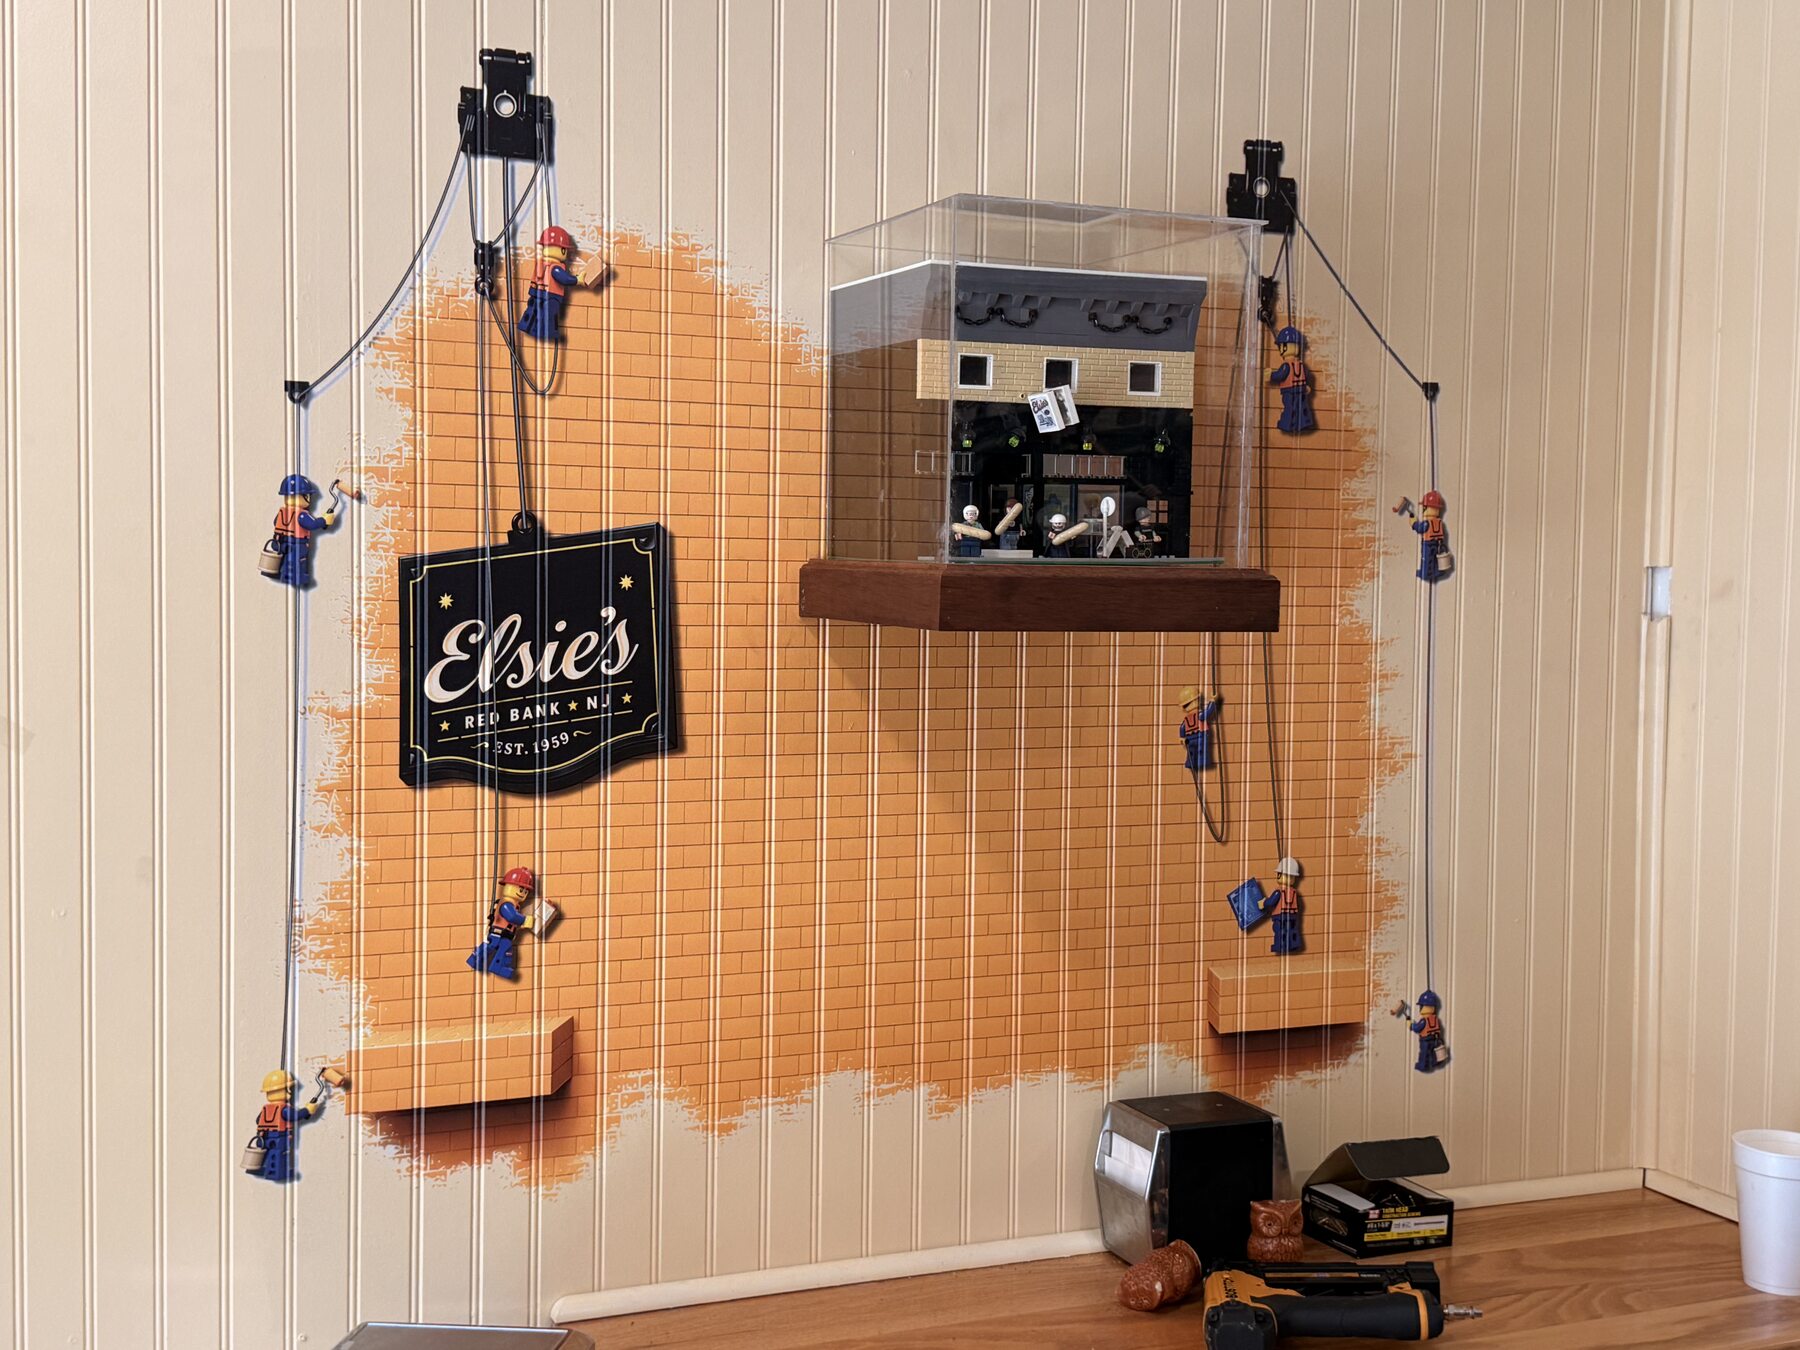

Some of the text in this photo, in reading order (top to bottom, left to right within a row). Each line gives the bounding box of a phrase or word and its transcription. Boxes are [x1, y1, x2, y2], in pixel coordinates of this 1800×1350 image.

[424, 606, 639, 703] Elsie's
[464, 694, 611, 729] RED BANK NJ
[493, 731, 570, 755] EST. 1959
